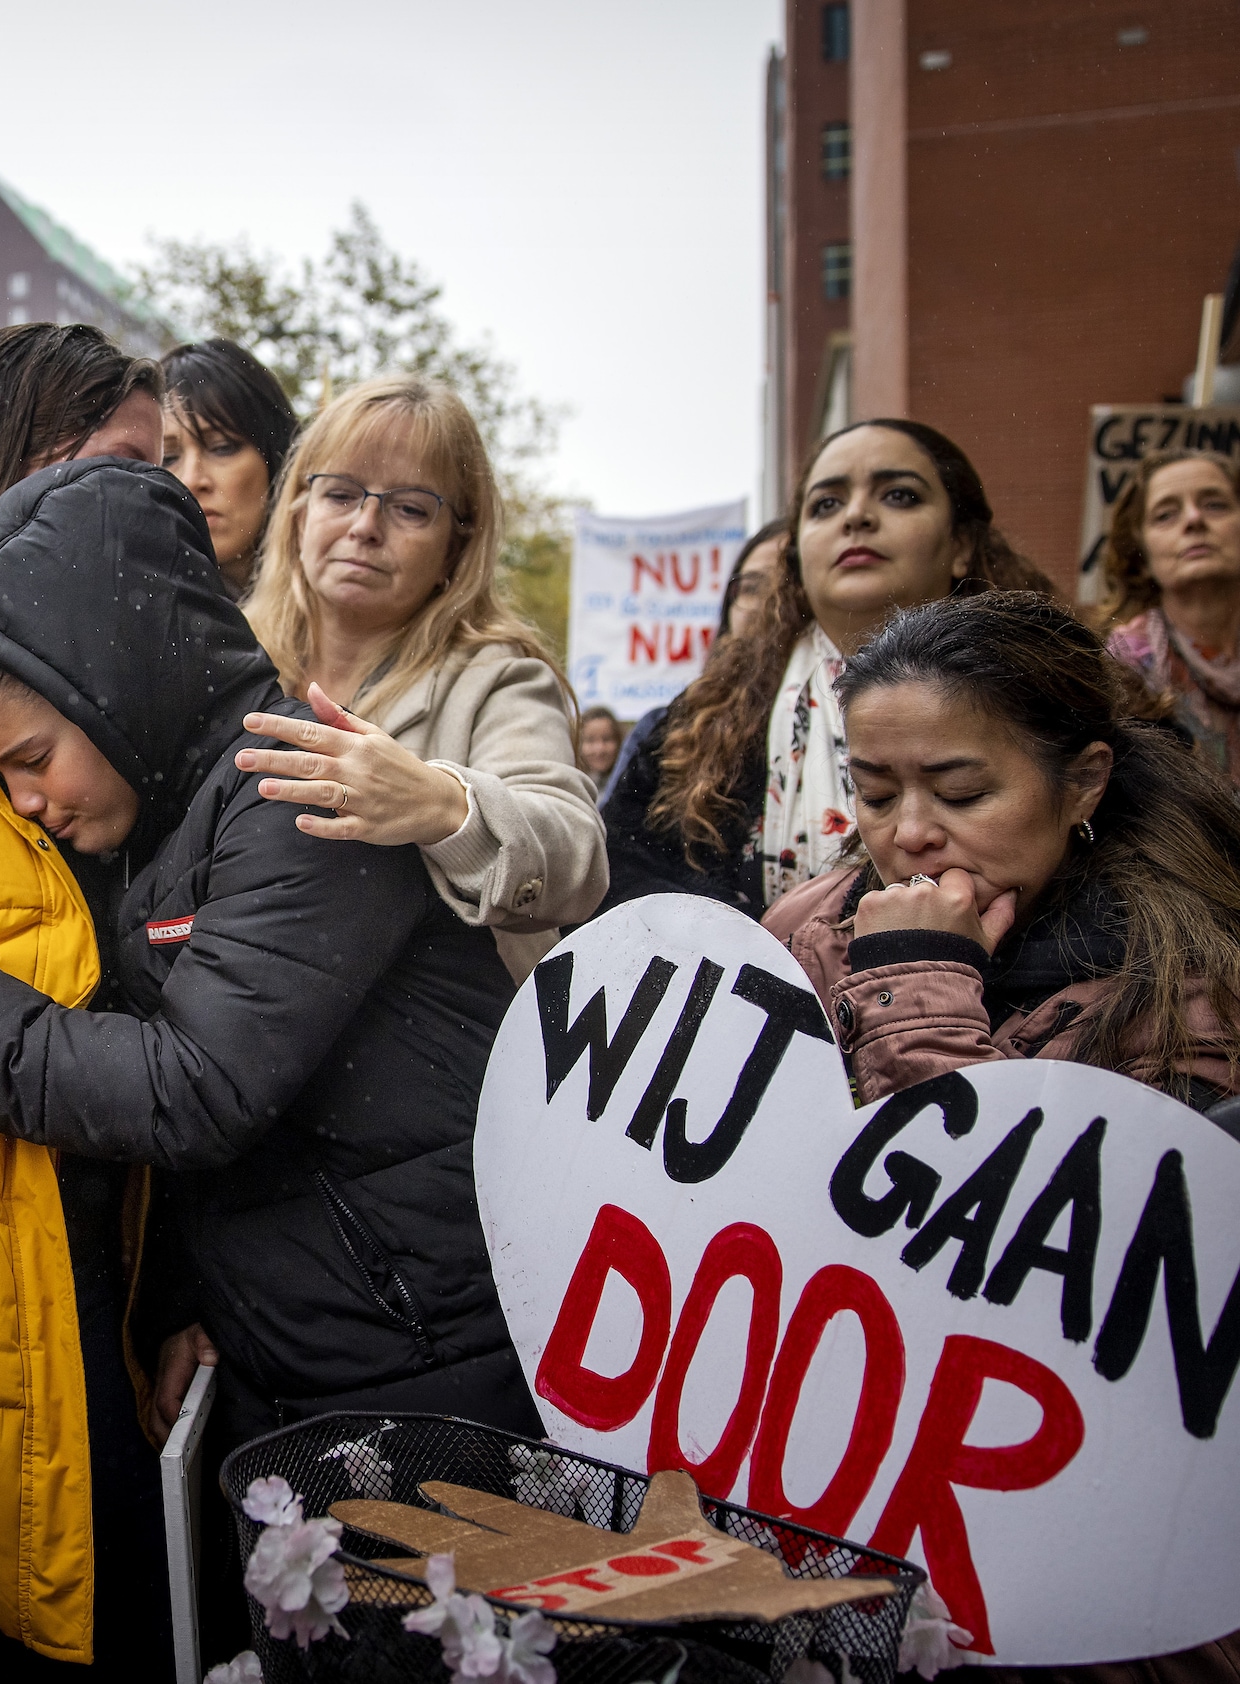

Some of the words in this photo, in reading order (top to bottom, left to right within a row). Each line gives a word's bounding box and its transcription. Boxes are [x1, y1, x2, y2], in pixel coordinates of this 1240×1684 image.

[631, 546, 720, 594] NU!
[534, 950, 836, 1184] WIJ
[830, 1071, 1240, 1440] GAAN
[535, 1204, 1085, 1656] DOOR
[486, 1540, 714, 1611] STOP
